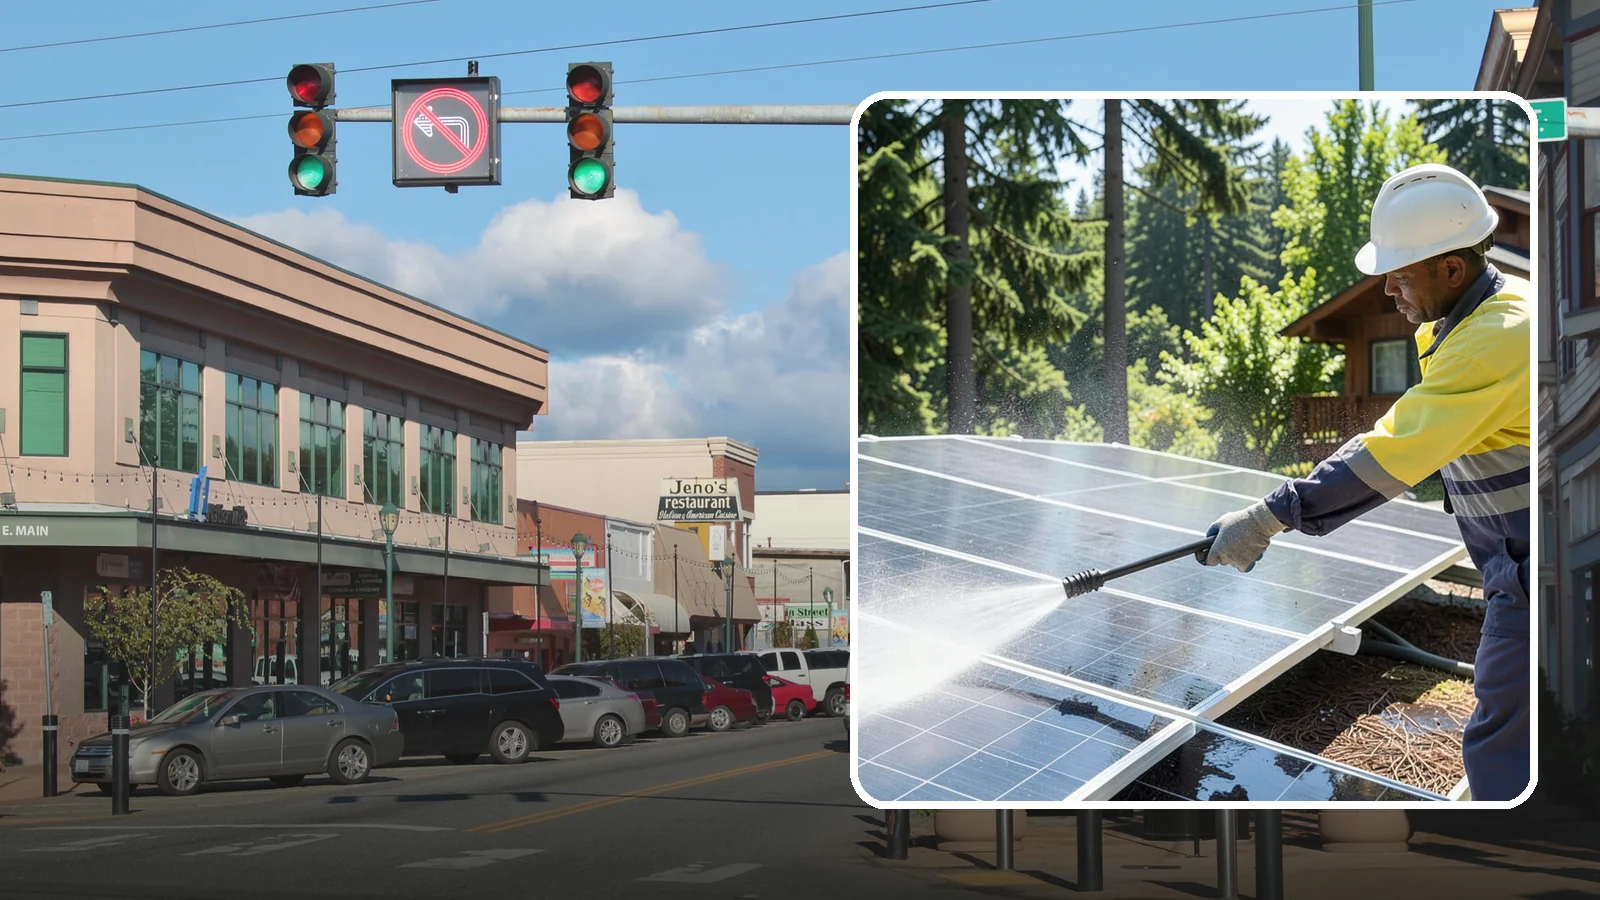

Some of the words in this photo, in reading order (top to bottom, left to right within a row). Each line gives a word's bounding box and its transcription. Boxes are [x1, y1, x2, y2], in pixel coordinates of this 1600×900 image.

[669, 480, 728, 495] Jeno's
[665, 496, 731, 509] restaurant
[658, 510, 681, 519] Italian
[686, 510, 714, 519] American
[715, 509, 738, 519] Cuisine
[2, 525, 13, 536] E.
[15, 525, 49, 536] MAIN
[797, 607, 828, 617] Street
